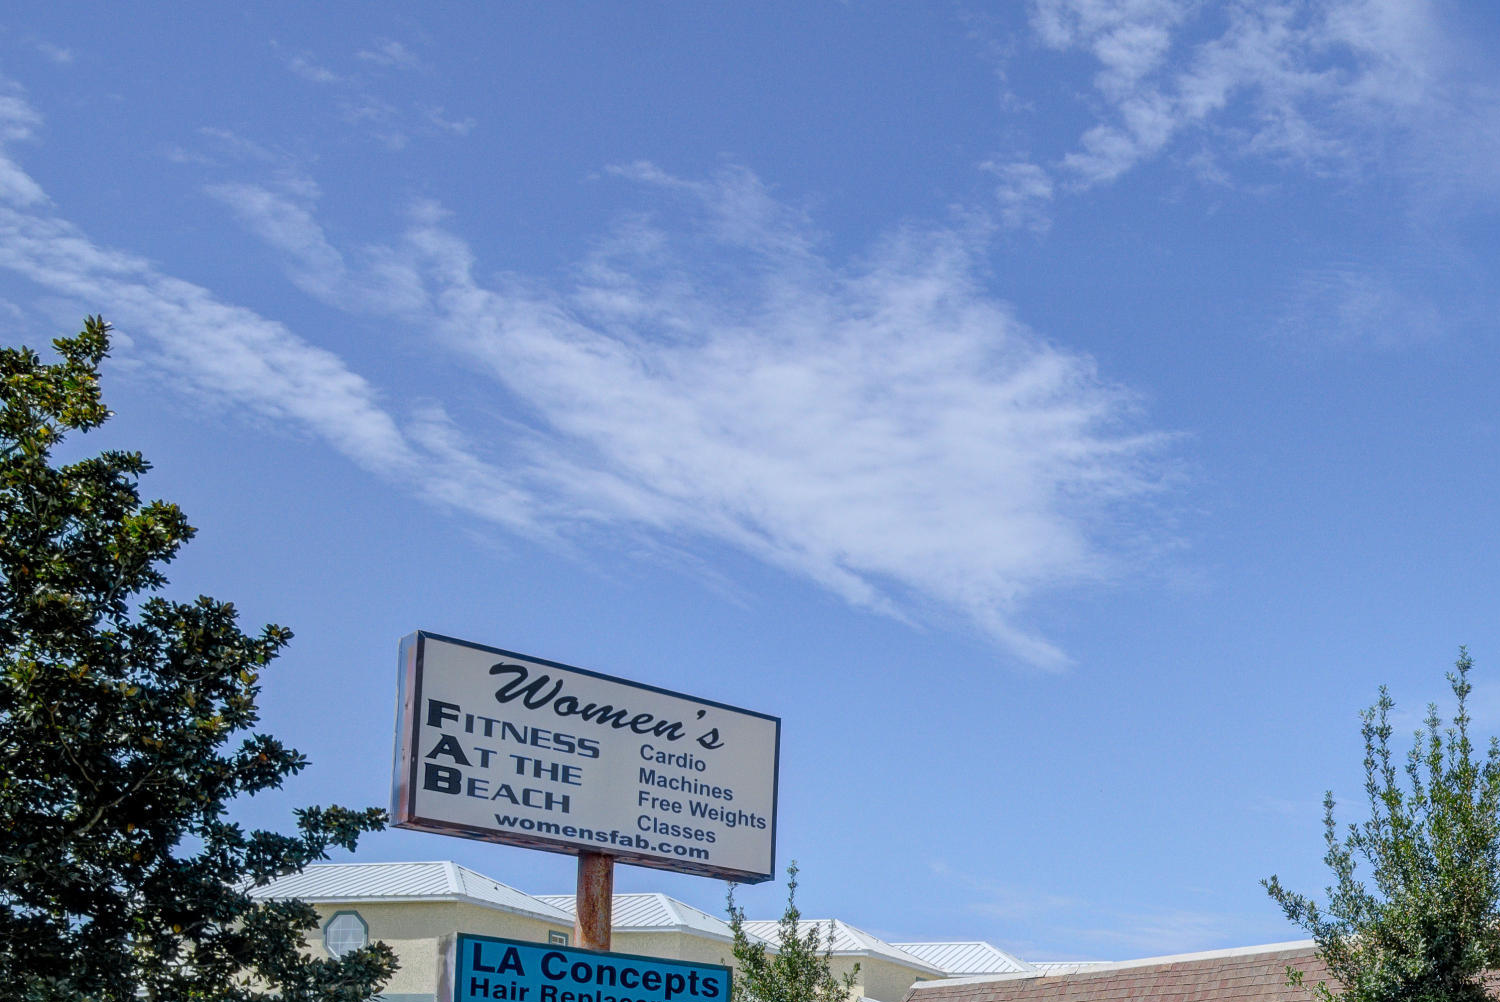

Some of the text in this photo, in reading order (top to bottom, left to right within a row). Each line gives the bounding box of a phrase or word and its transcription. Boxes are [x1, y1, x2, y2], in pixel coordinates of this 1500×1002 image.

[426, 699, 600, 758] FITNESS
[489, 662, 725, 750] Women's
[425, 734, 582, 786] AT THE
[640, 744, 706, 772] Cardio
[423, 762, 570, 813] BEACH
[639, 768, 733, 801] Machines
[638, 791, 766, 831] Free Weights
[638, 815, 716, 844] Classes
[495, 813, 709, 860] womensfab.com
[470, 977, 529, 1002] Hair
[473, 943, 719, 998] LA Concepts
